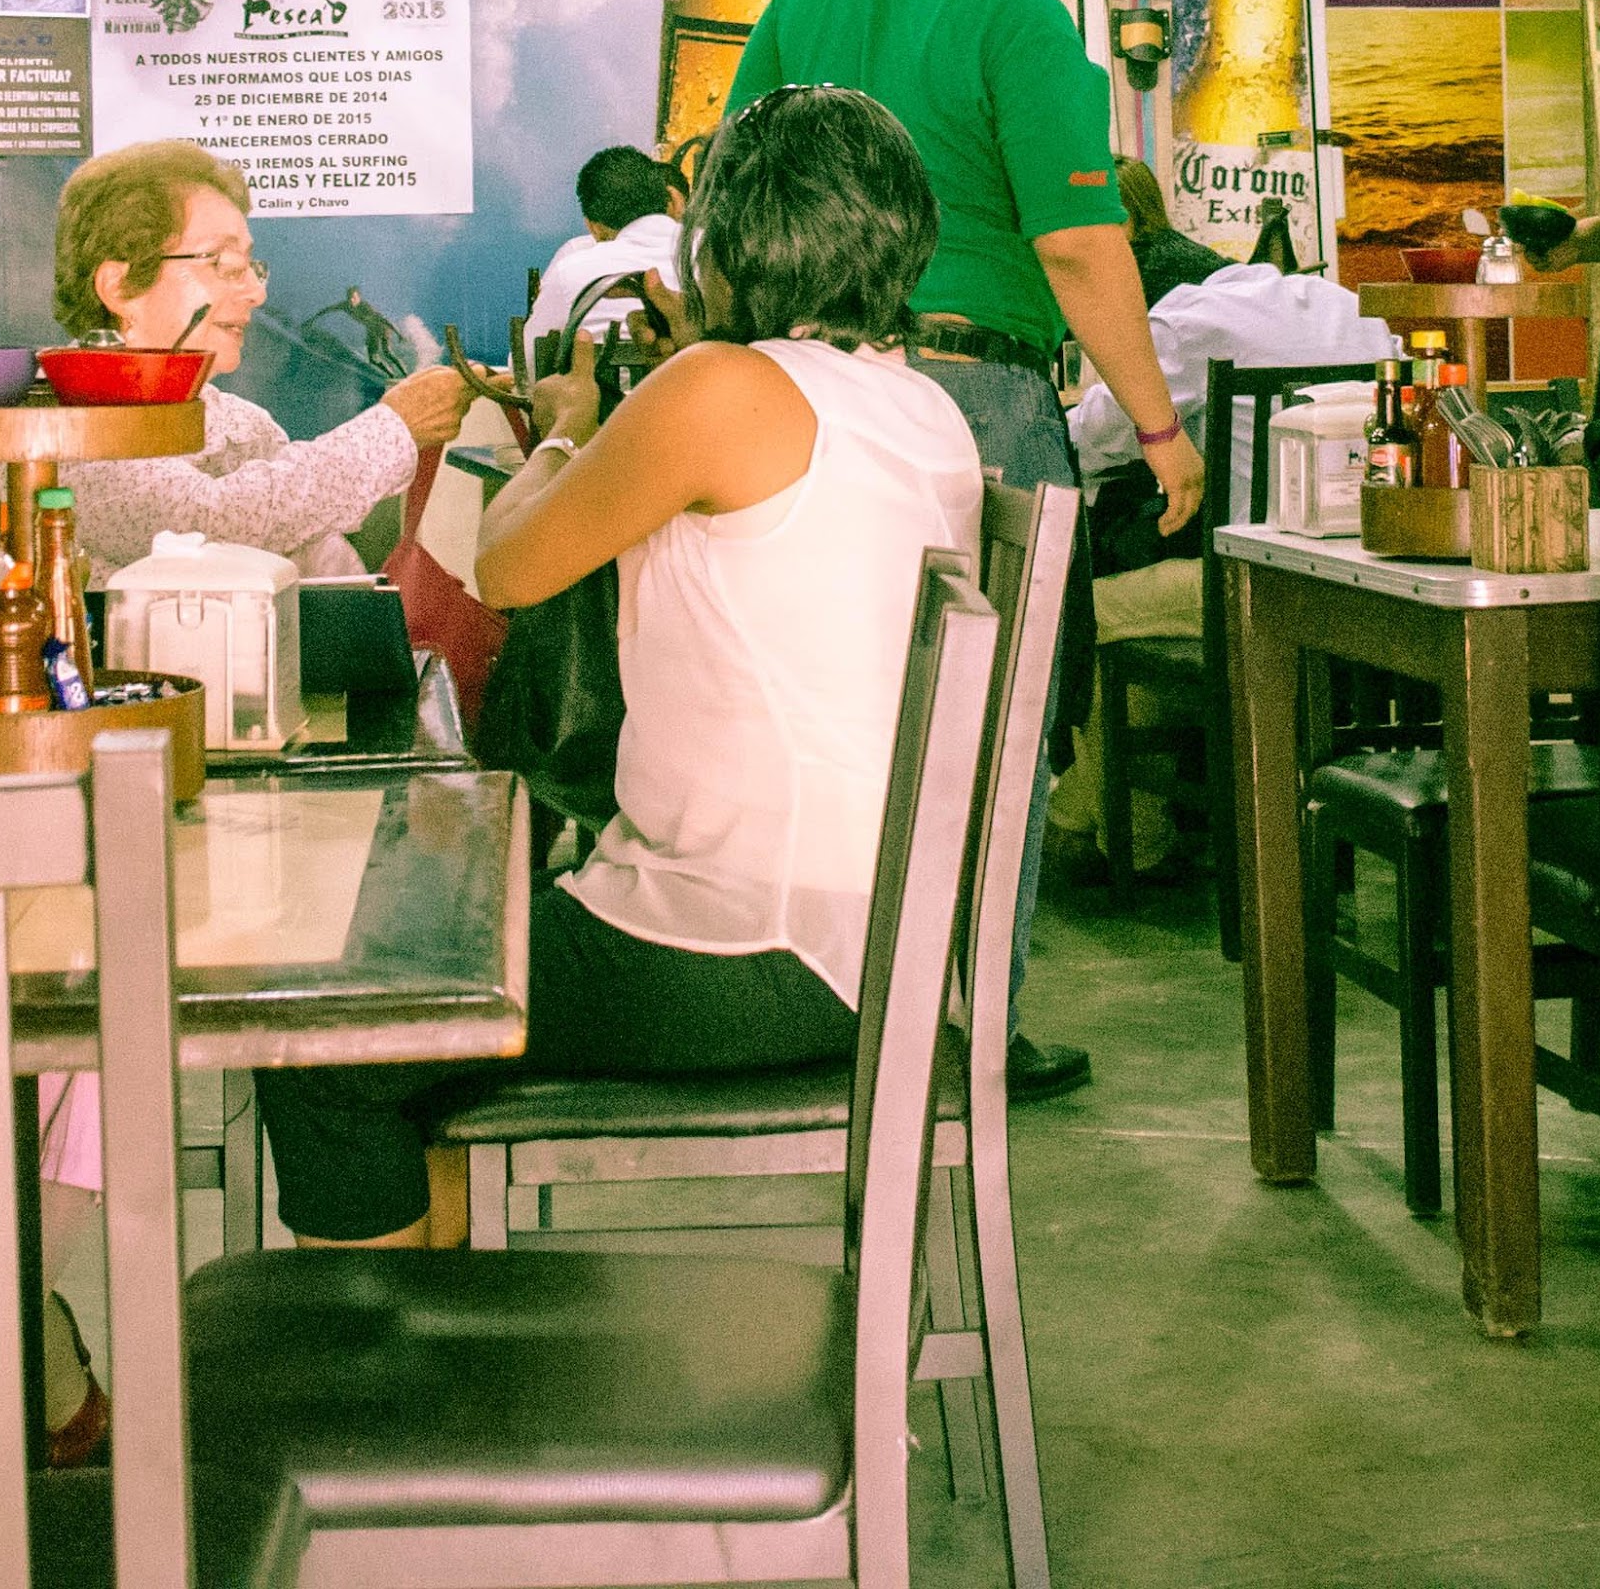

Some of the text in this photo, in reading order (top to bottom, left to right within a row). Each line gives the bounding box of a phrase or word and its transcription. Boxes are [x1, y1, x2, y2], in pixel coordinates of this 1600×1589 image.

[135, 49, 444, 66] A TODOS NUESTROS CLIENTES Y AMIGOS
[10, 69, 72, 83] FACTURA?
[169, 70, 413, 86] LES INFORMAMOS QUE LOS DIAS
[194, 91, 388, 106] 25 DE DICIEMBRE DE 2014
[199, 116, 208, 127] Y
[233, 115, 252, 126] DE
[257, 114, 308, 126] ENERO
[313, 113, 332, 125] DE
[337, 113, 372, 125] 2015
[317, 133, 389, 146] CERRADO
[256, 157, 315, 169] IREMOS
[319, 156, 337, 168] AL
[342, 155, 408, 168] SURFING
[247, 172, 417, 190] ACIAS Y FELIZ 2015
[1180, 152, 1308, 199] Corona
[296, 200, 305, 210] y
[308, 196, 350, 208] Chavo
[1208, 199, 1262, 224] Ext
